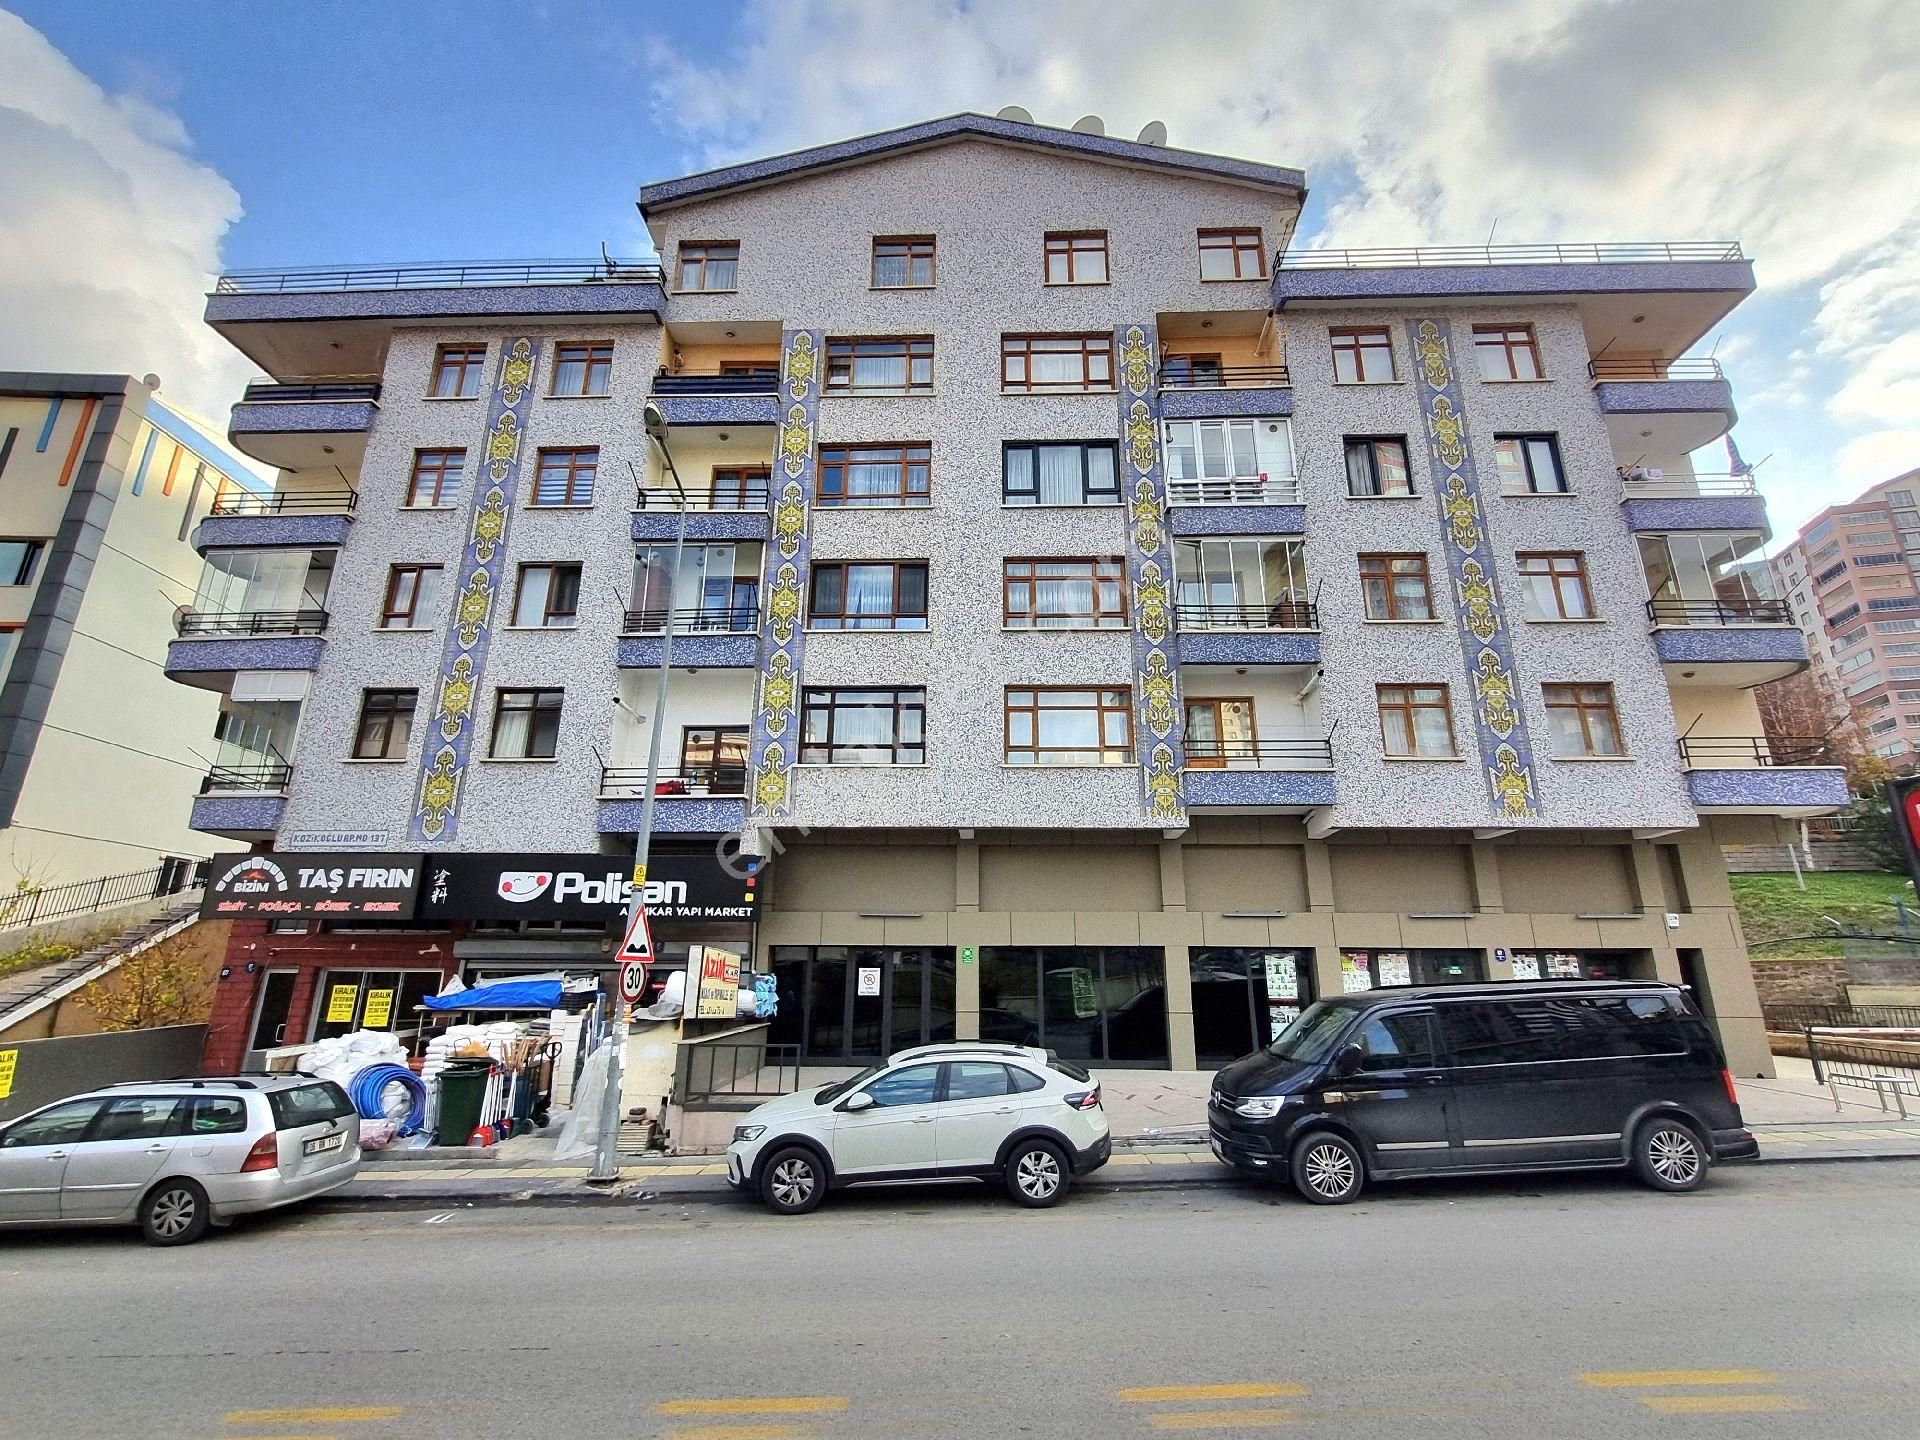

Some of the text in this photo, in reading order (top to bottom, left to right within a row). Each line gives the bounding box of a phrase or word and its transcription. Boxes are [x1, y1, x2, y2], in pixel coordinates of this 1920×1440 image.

[234, 880, 269, 892] BİZİM
[299, 868, 414, 893] TAŞ FIRIN
[553, 872, 687, 904] Polisan
[257, 900, 301, 913] POĞAÇA
[619, 907, 753, 917] AKAR YAPI MARKET
[627, 967, 640, 990] 30
